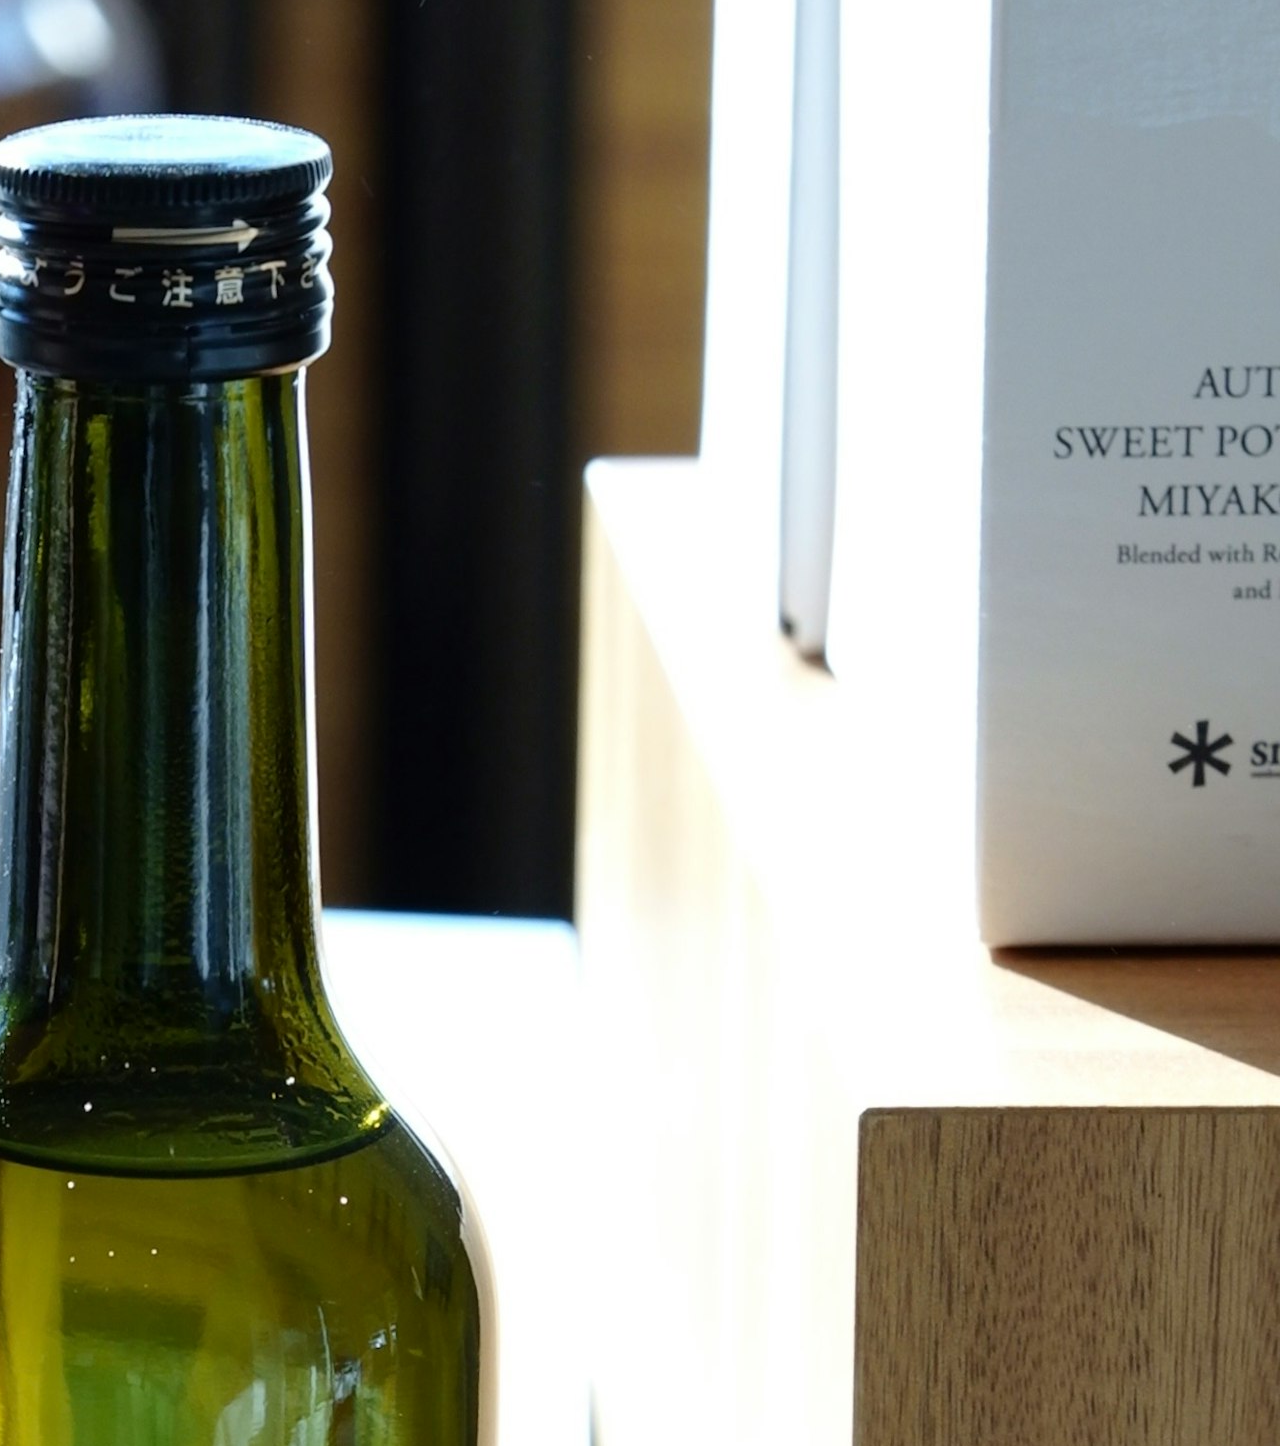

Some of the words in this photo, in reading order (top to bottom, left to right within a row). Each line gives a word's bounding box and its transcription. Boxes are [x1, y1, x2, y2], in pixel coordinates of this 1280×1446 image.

[1054, 426, 1203, 460] SWEET
[1217, 425, 1280, 458] PO
[1138, 484, 1280, 517] MIYAK
[1117, 544, 1201, 565] Blended
[1209, 543, 1254, 564] with
[1233, 580, 1272, 600] and
